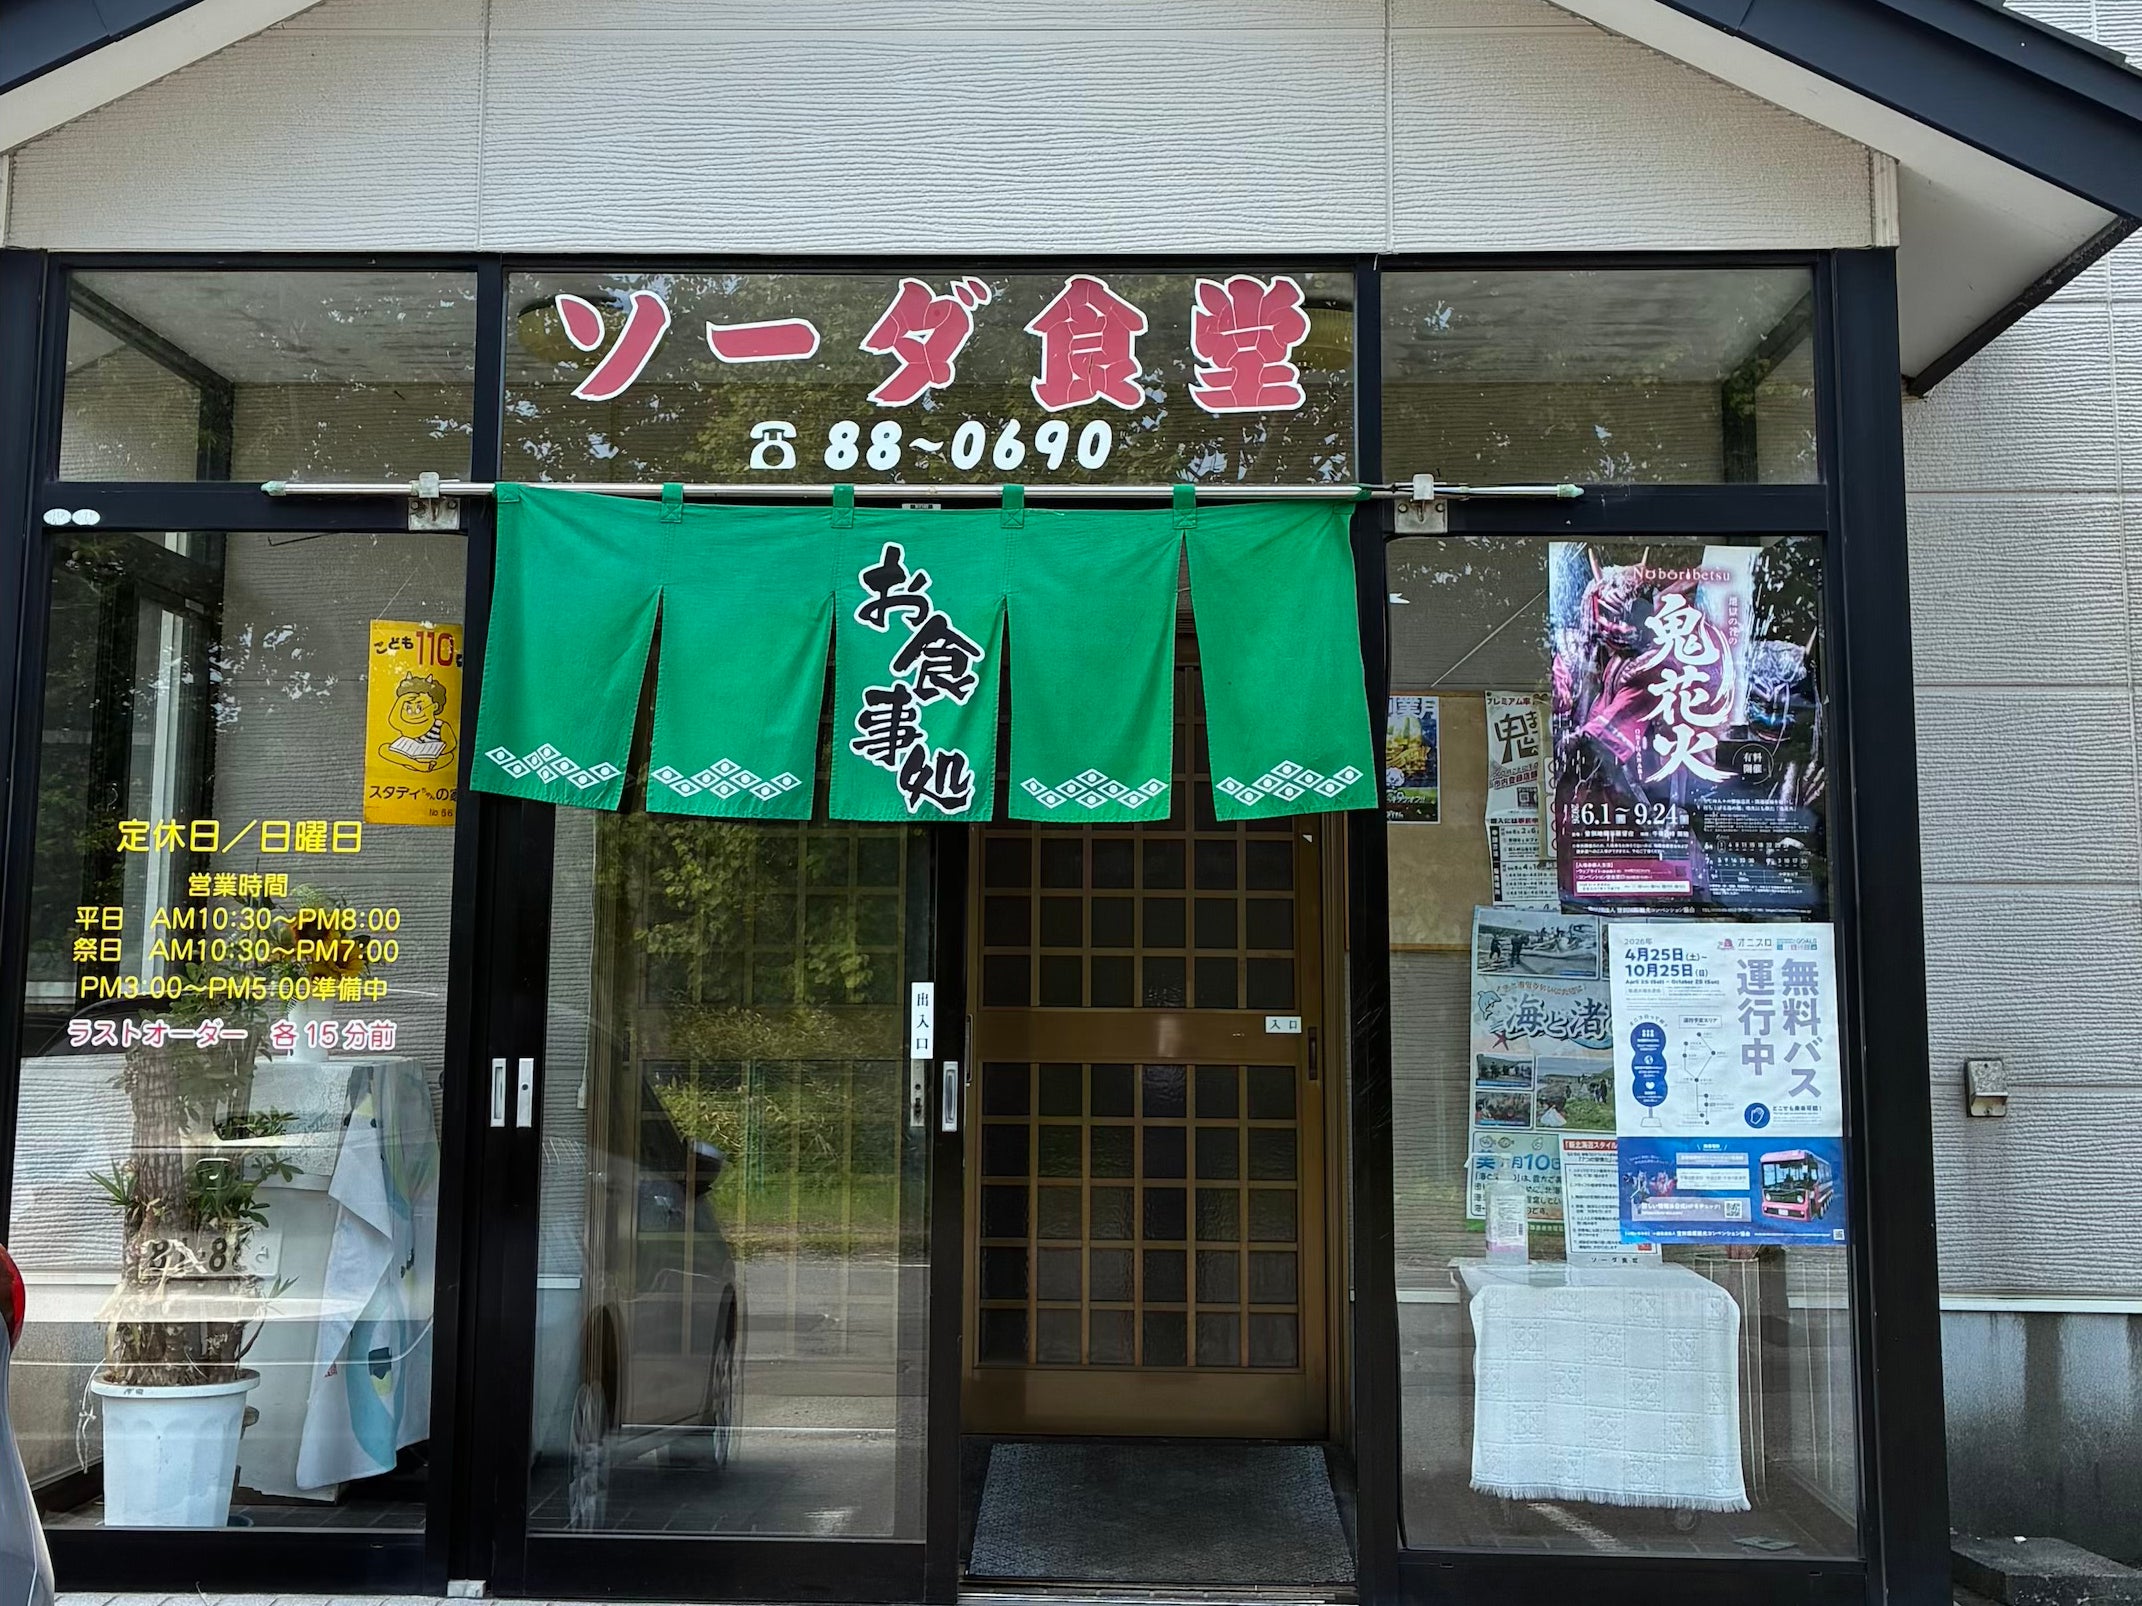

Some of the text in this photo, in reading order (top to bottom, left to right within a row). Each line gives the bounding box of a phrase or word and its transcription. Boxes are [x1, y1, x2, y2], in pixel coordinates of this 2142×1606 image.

[554, 275, 1311, 413] ソーダ食堂
[1633, 566, 1731, 582] Noboribetsu
[374, 631, 462, 668] こども110
[850, 541, 985, 815] お食事処
[1636, 593, 1739, 784] 鬼花火
[116, 819, 363, 853] 定休日／日曜日
[188, 872, 288, 898] 営業時間
[75, 906, 124, 932] 平日
[72, 938, 122, 963] 祭日
[67, 1019, 248, 1049] ラストオーダー
[916, 992, 930, 1050] 出入口
[1270, 1019, 1297, 1029] 入口
[1736, 958, 1775, 1076] 運行中
[1781, 958, 1822, 1099] 無料バス
